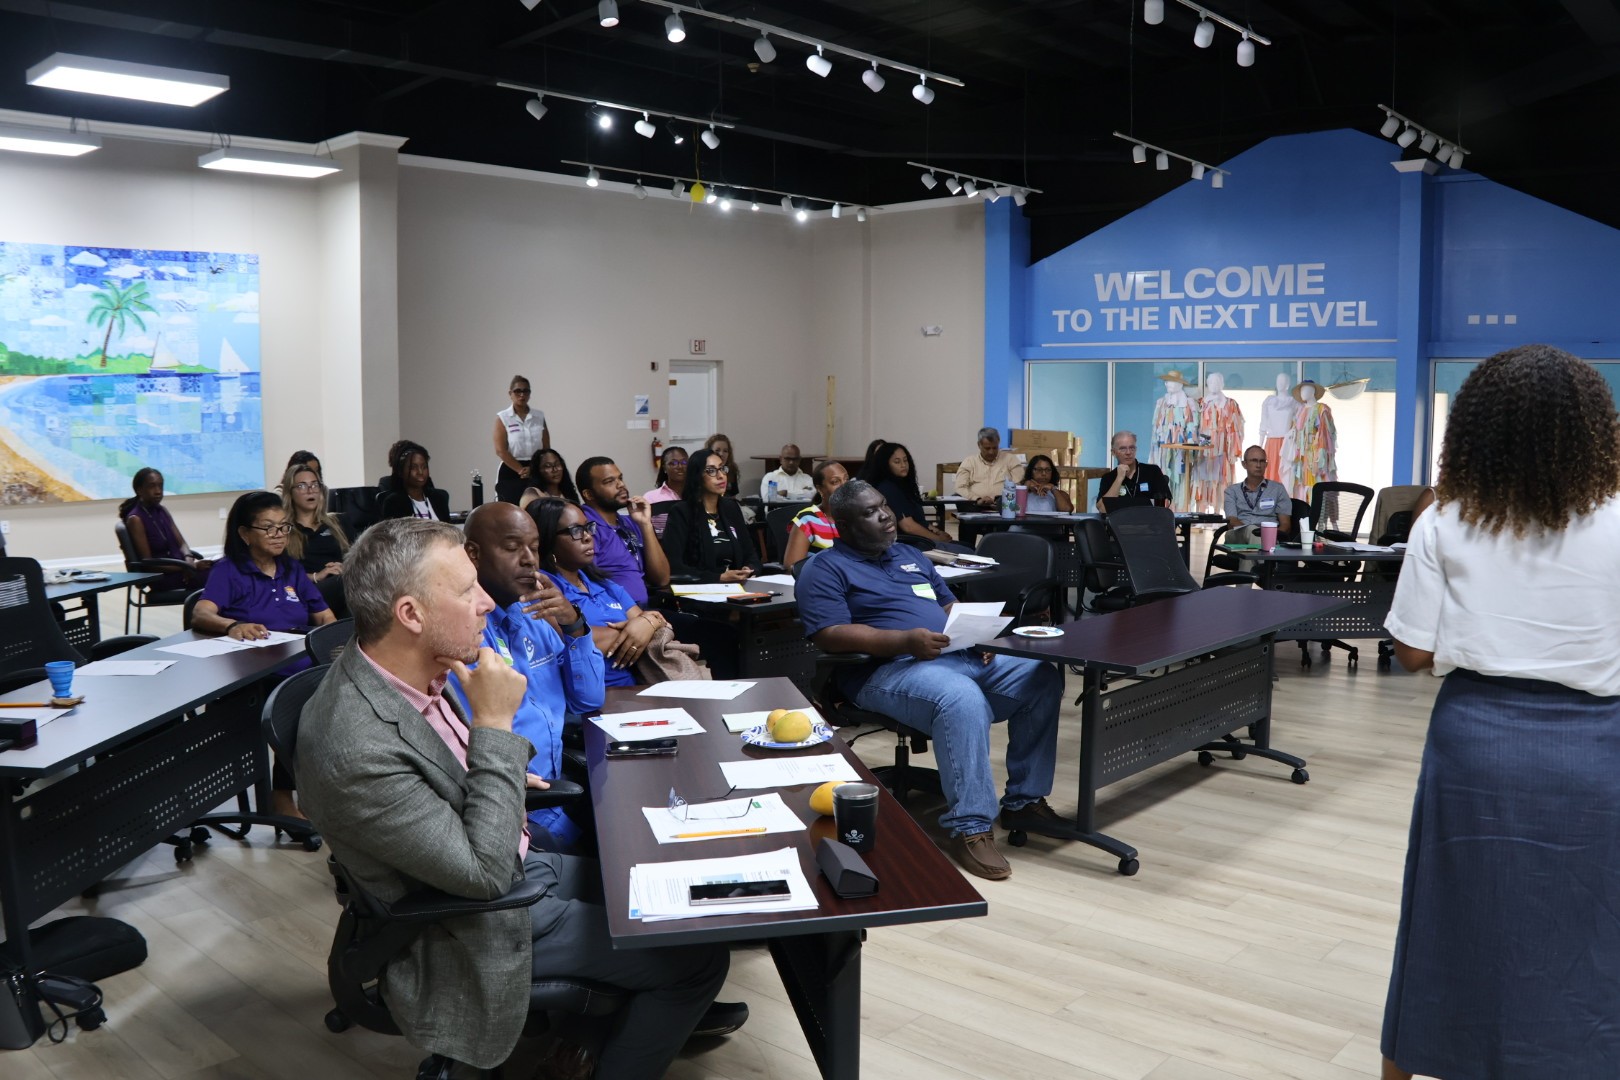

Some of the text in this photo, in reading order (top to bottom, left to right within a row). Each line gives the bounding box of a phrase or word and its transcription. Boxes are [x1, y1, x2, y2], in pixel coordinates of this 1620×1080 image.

[1093, 262, 1326, 302] WELCOME
[1052, 300, 1378, 333] TO THE NEXT LEVEL
